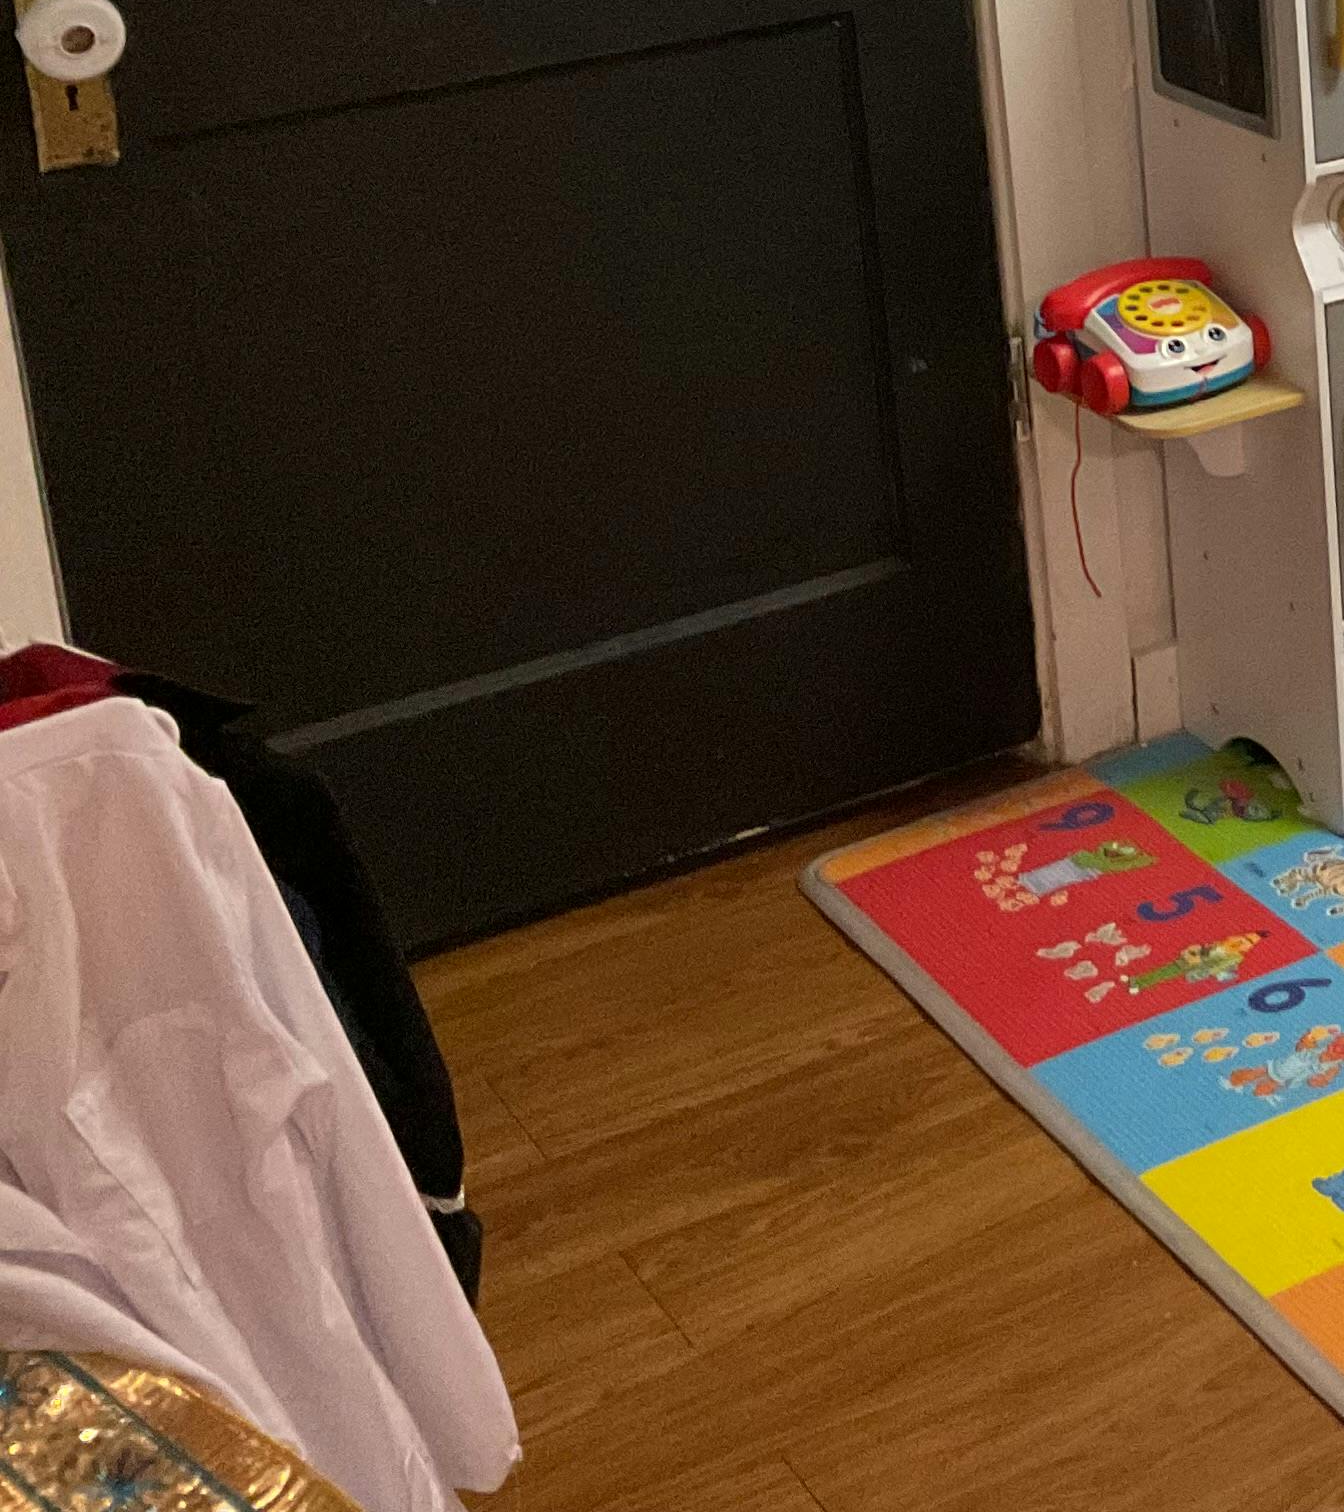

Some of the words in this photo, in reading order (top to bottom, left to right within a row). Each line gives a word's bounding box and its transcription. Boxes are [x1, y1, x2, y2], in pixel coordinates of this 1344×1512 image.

[1037, 802, 1116, 832] 9
[1137, 885, 1223, 922] 5
[1249, 978, 1333, 1013] 6
